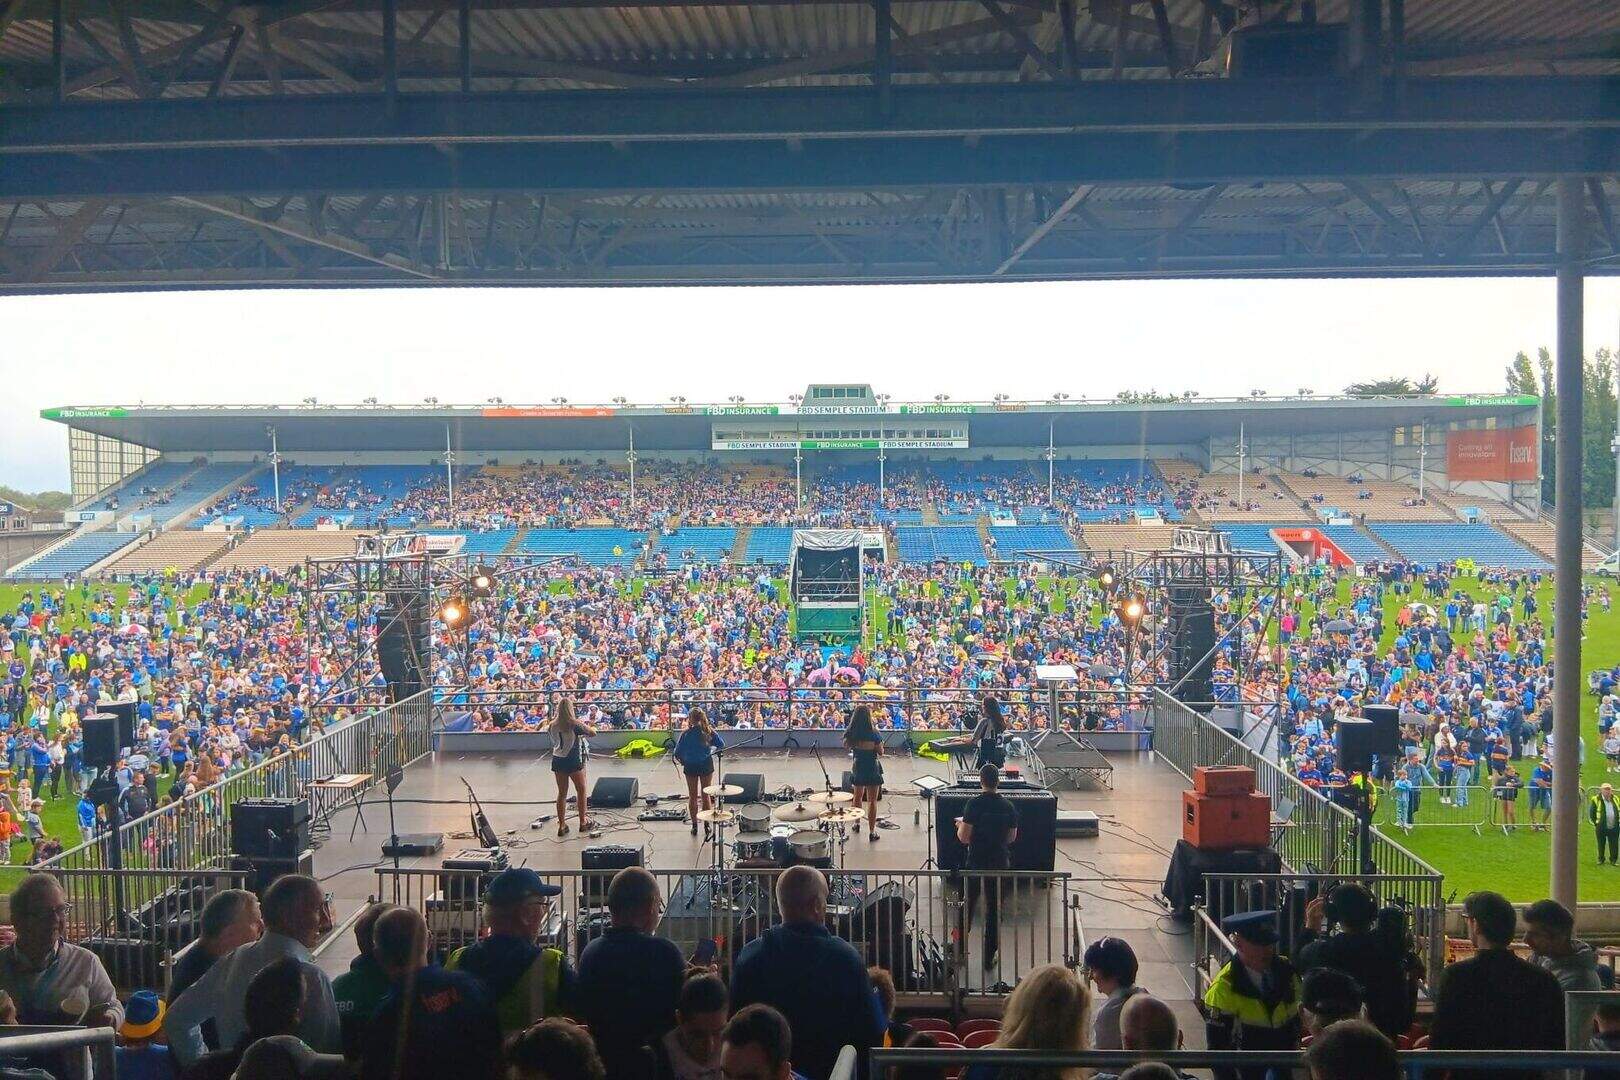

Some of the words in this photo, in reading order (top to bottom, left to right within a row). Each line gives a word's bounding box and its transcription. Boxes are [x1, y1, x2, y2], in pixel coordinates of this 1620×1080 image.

[1465, 398, 1481, 406] FBD
[707, 407, 726, 415] FBD
[797, 407, 814, 415] FBD
[849, 406, 886, 414] STADIUM
[727, 441, 740, 449] FBD
[741, 441, 767, 449] SEMPLE
[768, 441, 797, 449] STADIUM
[883, 441, 897, 449] FBD
[898, 441, 924, 449] SEMPLE
[925, 441, 954, 449] STADIUM
